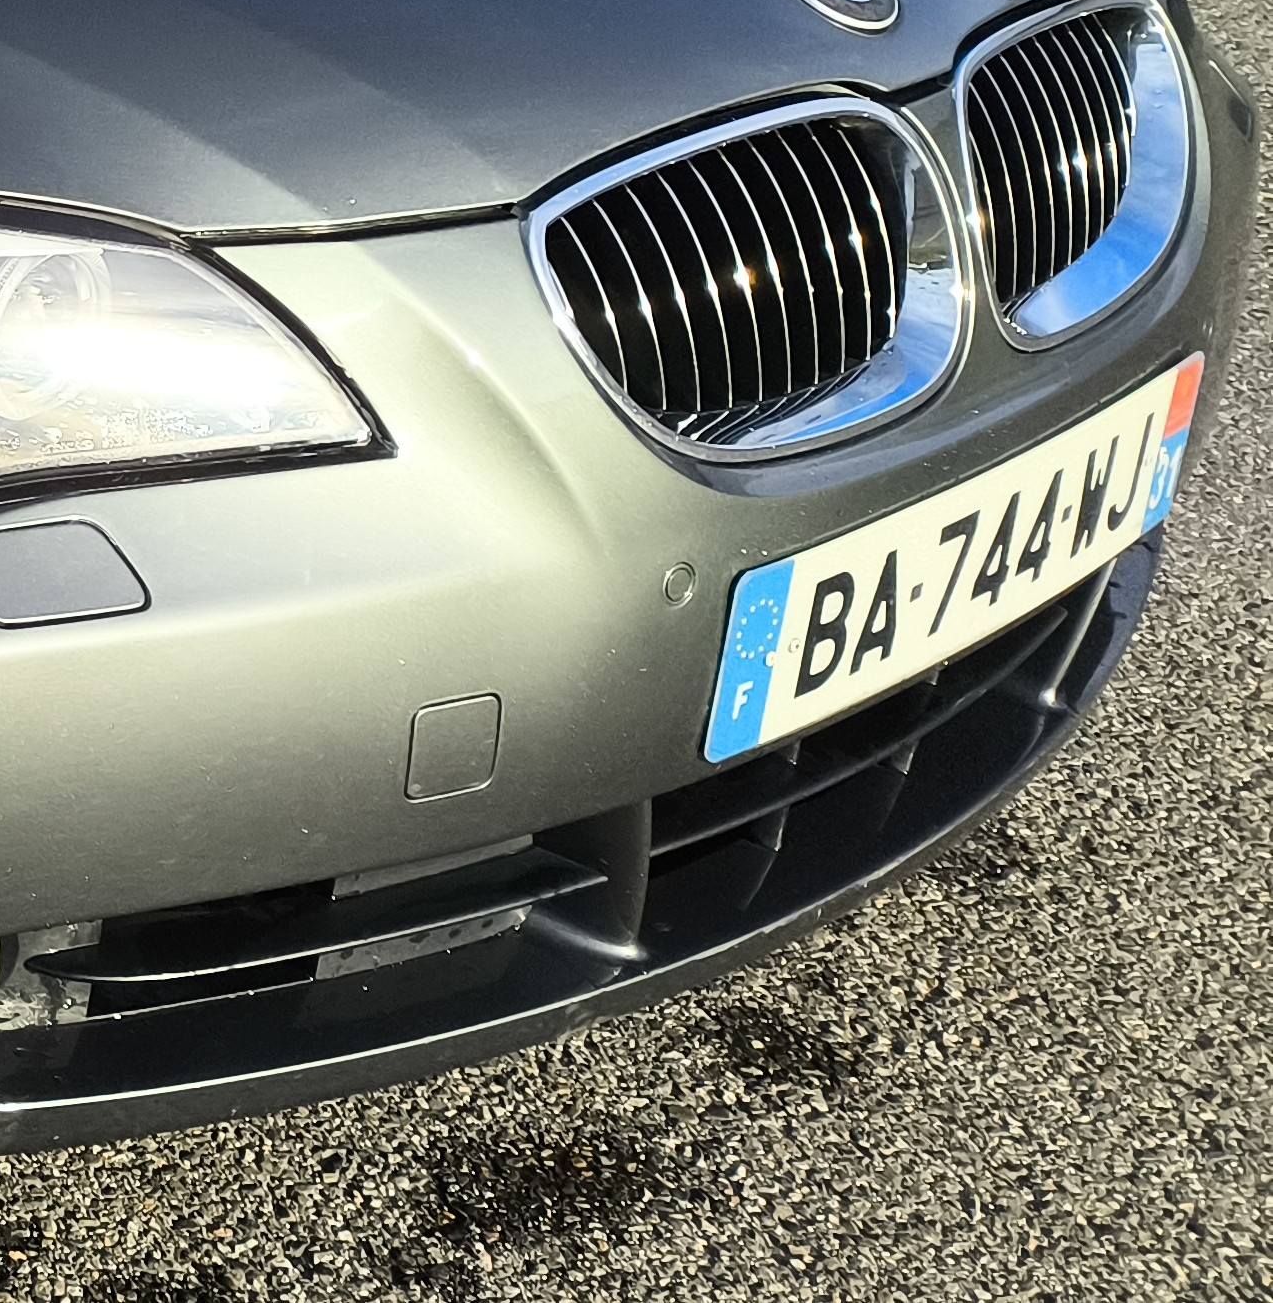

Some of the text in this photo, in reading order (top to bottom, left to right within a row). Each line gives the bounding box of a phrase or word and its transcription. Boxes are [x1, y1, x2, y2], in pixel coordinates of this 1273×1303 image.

[1148, 444, 1183, 510] 31
[793, 412, 1155, 699] BA-744-WJ
[732, 681, 754, 721] F
